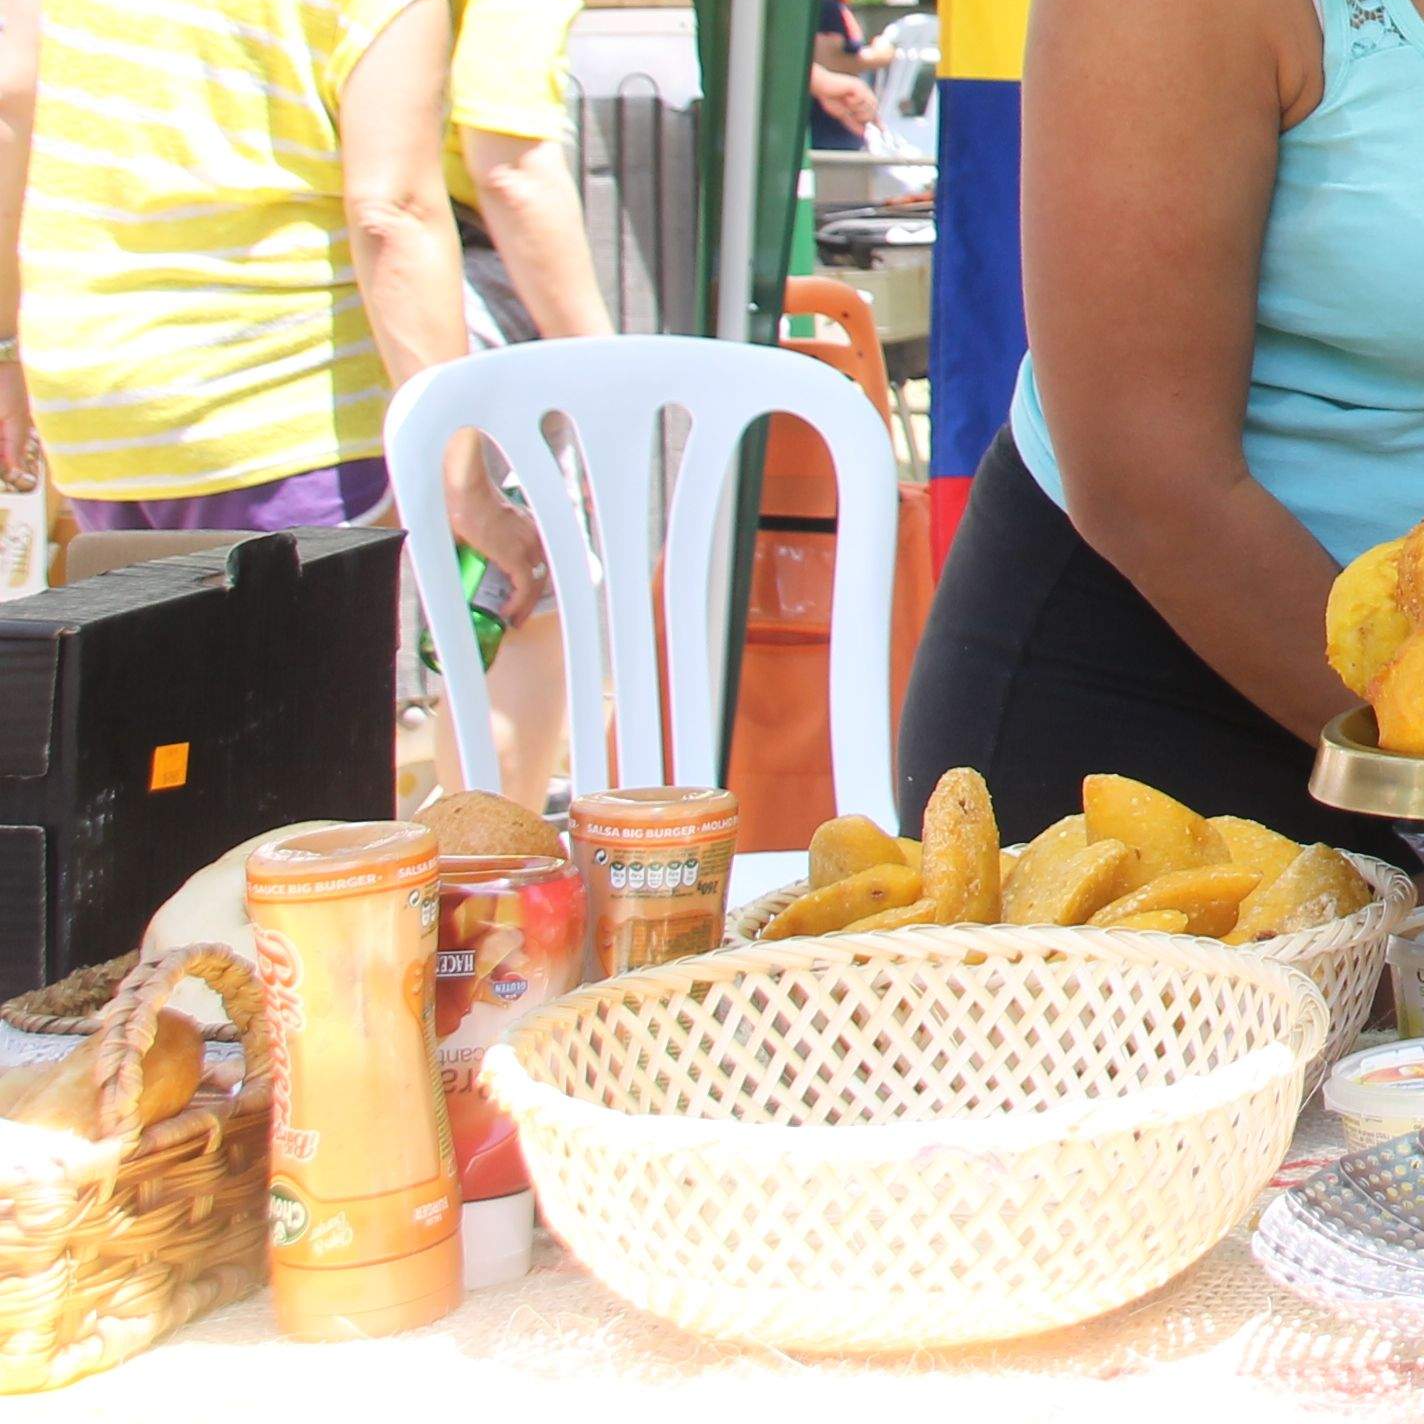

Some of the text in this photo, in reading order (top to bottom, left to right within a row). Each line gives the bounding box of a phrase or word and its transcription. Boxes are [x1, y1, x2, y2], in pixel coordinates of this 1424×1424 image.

[587, 822, 620, 838] SALSA
[622, 828, 643, 839] BIG
[645, 825, 696, 838] BURGER
[288, 881, 312, 894] BIG
[315, 873, 376, 893] BURGER
